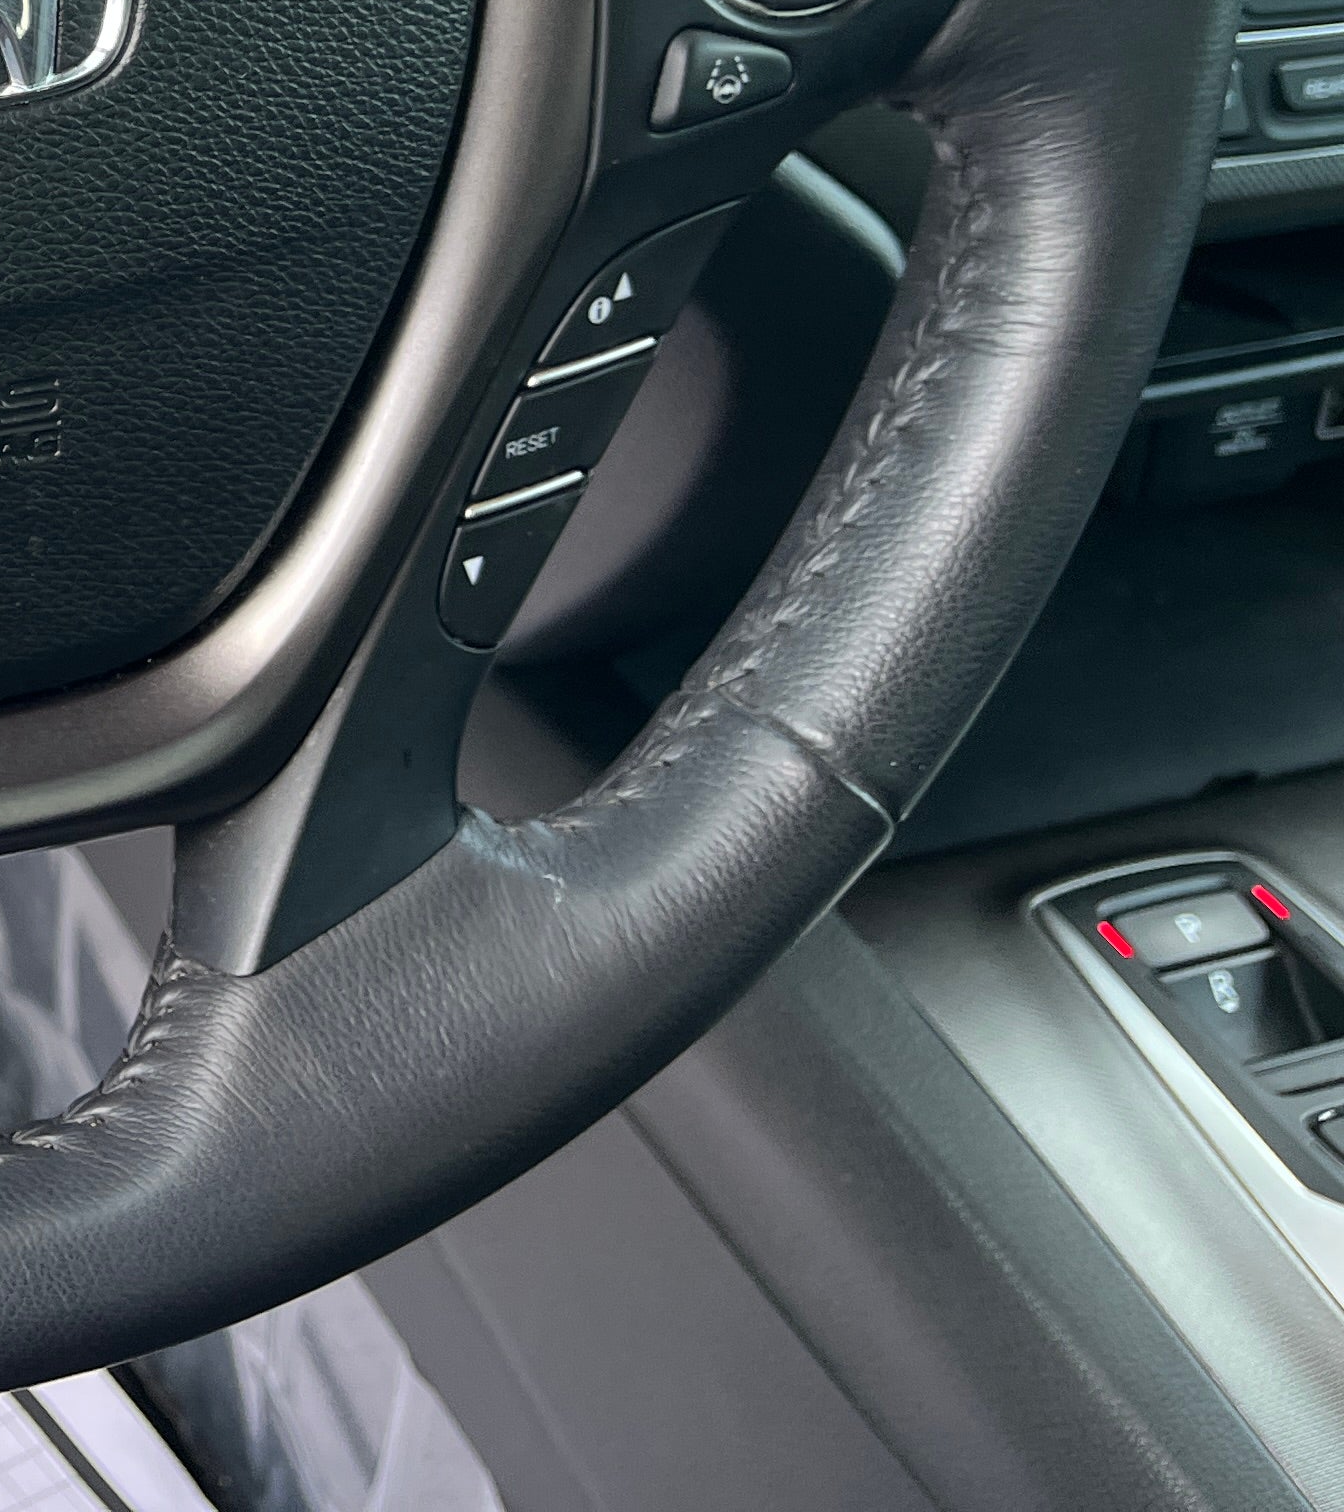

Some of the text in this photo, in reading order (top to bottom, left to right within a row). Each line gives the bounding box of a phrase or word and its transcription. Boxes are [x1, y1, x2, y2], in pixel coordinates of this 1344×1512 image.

[505, 426, 560, 459] RESET
[1174, 913, 1203, 944] P
[1208, 969, 1240, 1014] R
